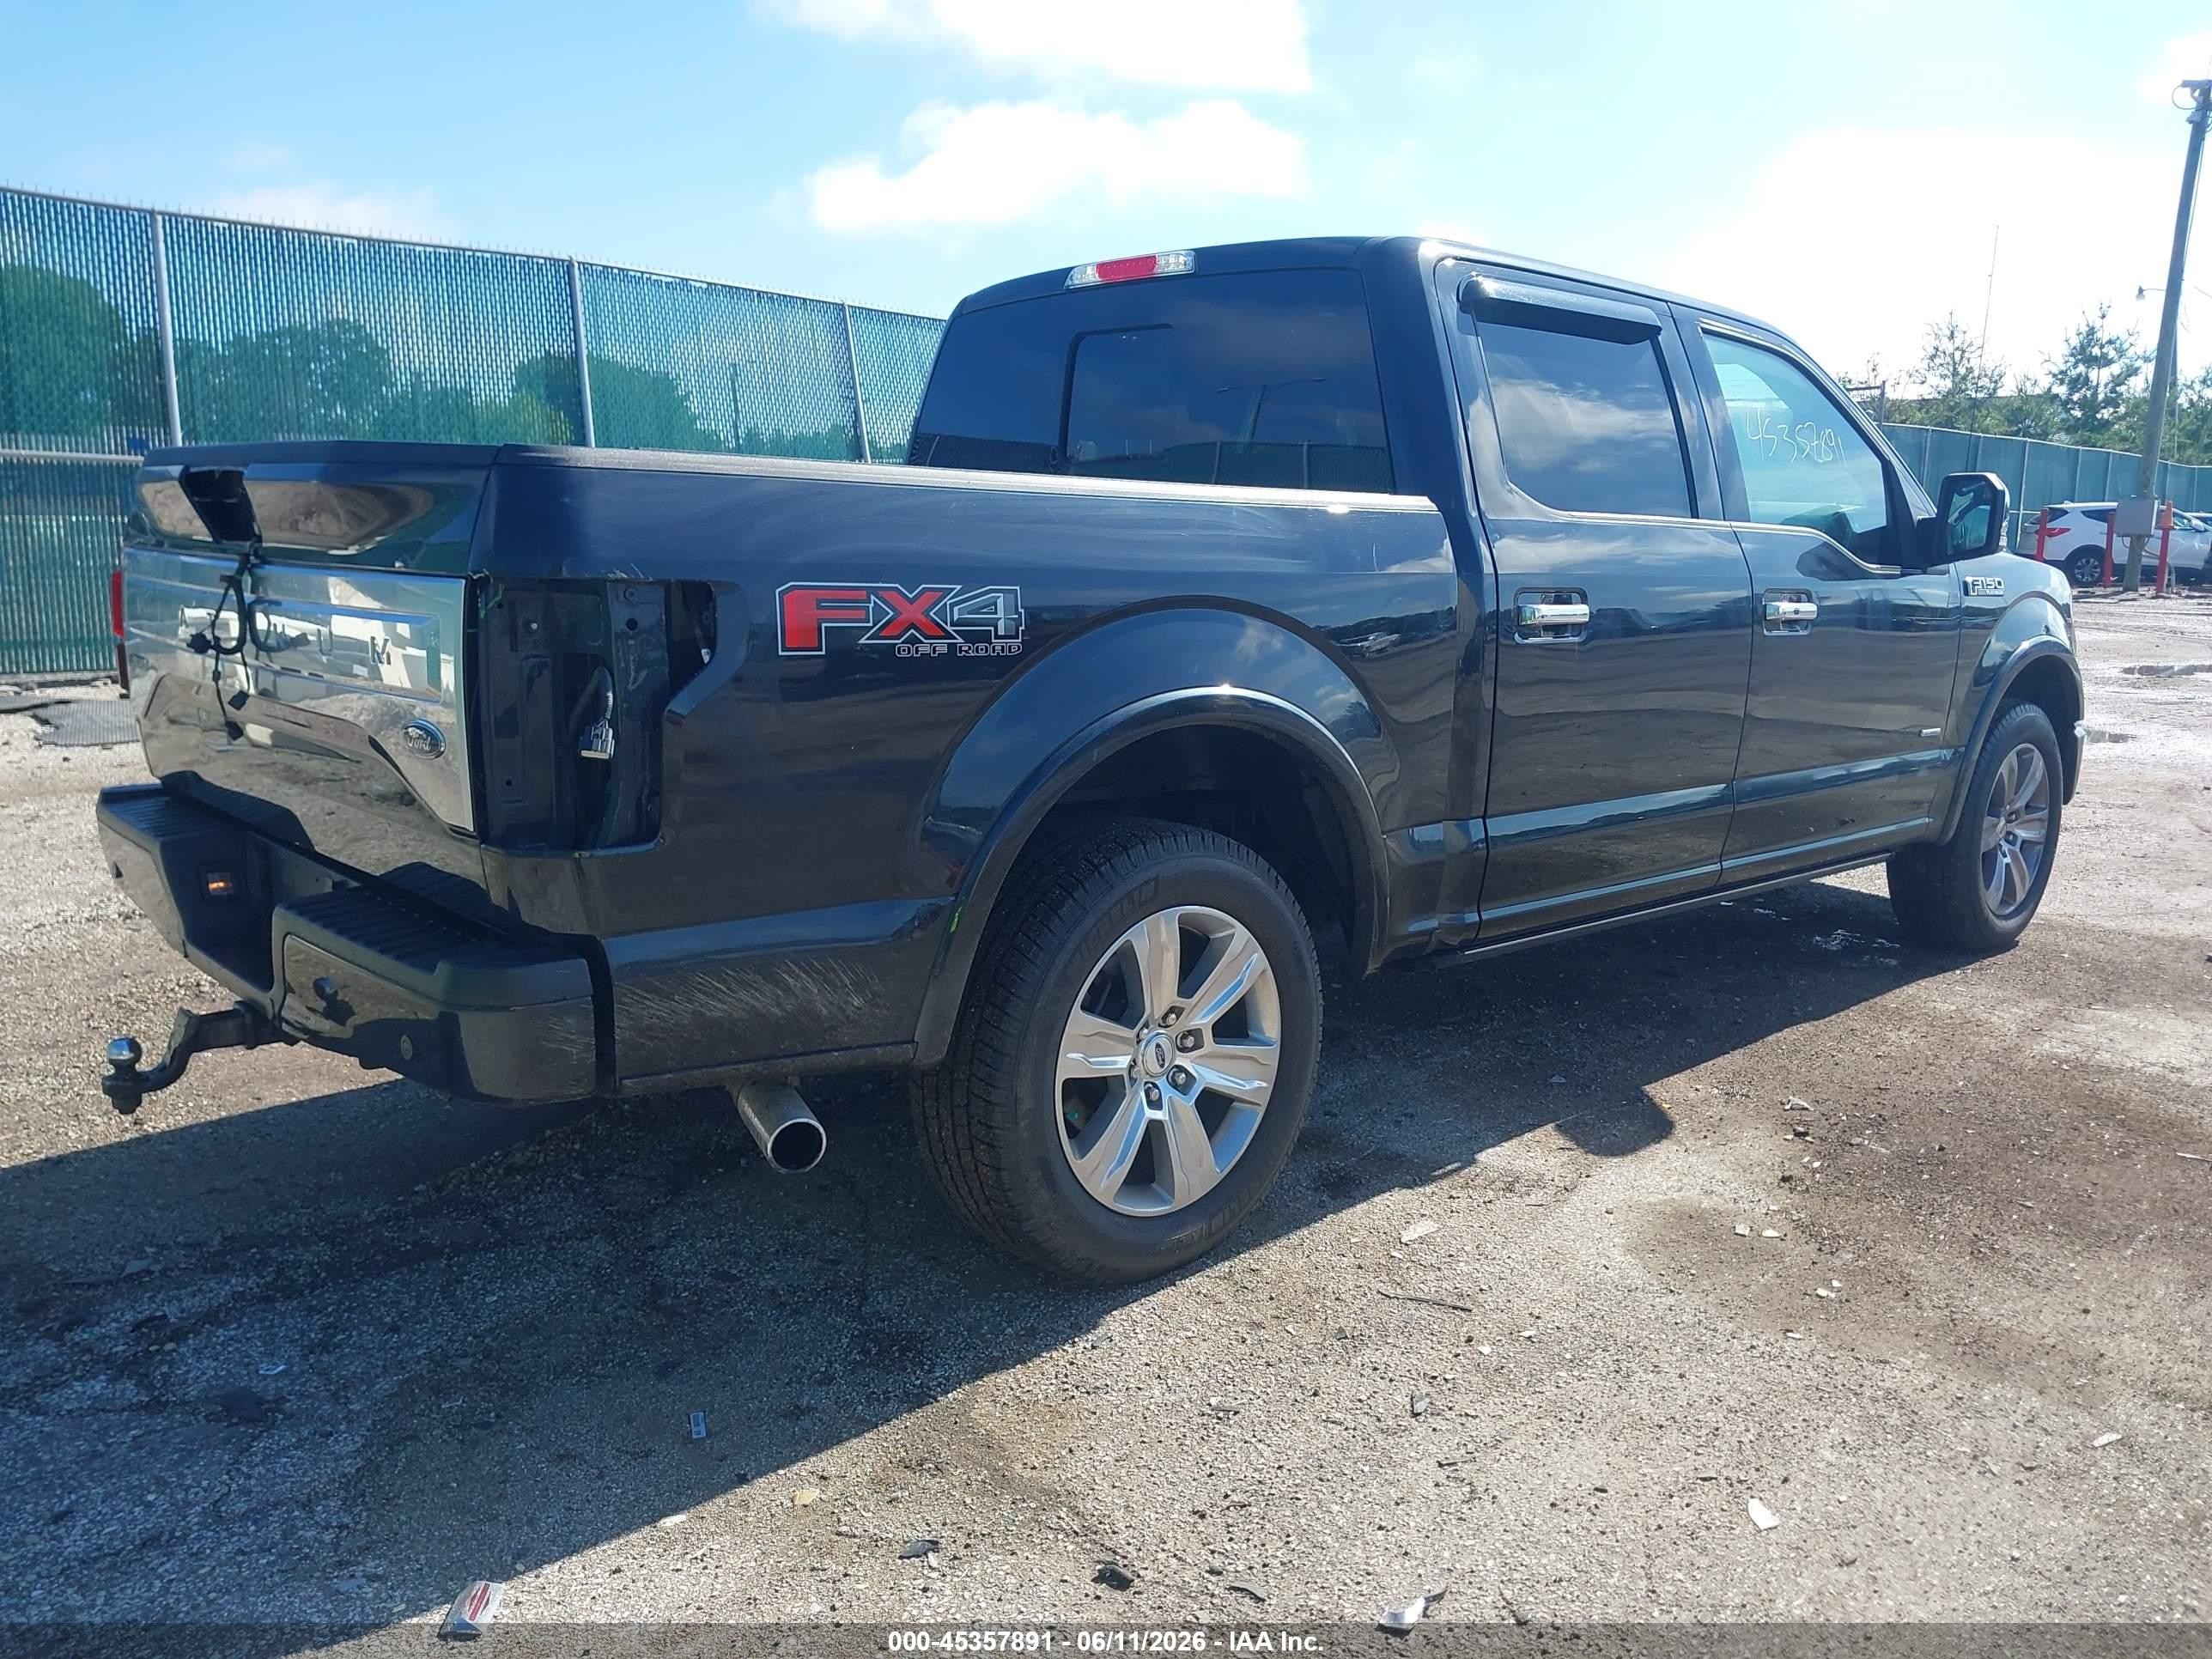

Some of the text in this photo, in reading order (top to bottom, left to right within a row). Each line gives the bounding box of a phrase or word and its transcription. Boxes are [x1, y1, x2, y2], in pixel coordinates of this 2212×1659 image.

[1746, 407, 1848, 464] 45357891
[775, 581, 1025, 655] FX4
[895, 642, 1023, 657] OFF ROAD
[403, 726, 431, 750] Ford
